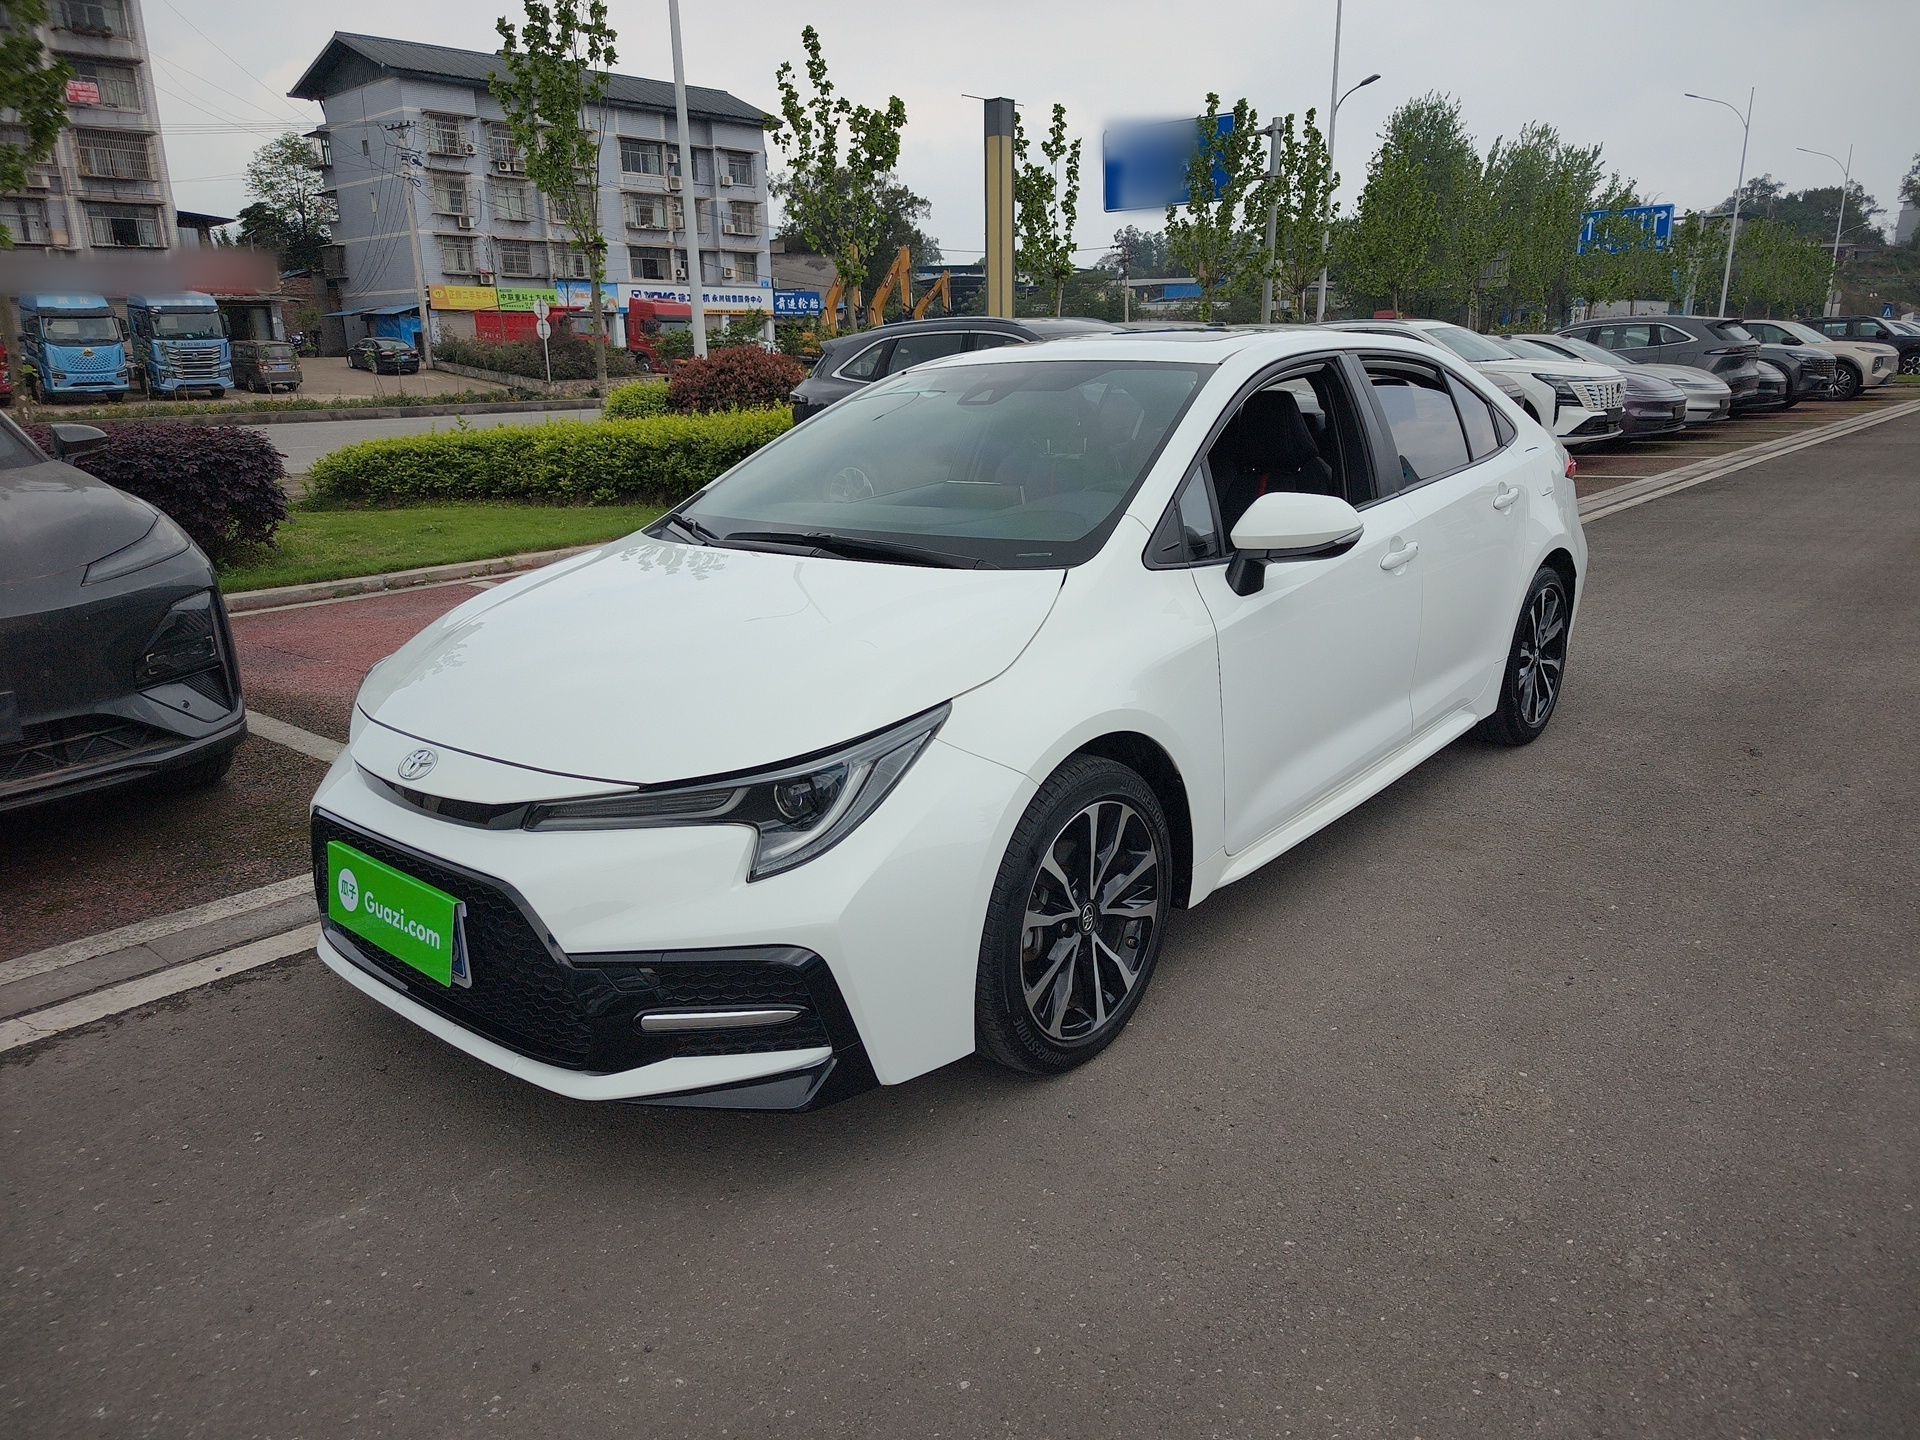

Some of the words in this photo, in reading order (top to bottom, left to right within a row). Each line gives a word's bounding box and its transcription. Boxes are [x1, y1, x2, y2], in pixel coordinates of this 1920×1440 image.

[500, 293, 556, 302] 中联重科土方机械
[776, 297, 819, 311] 前进轮胎
[340, 879, 357, 900] 瓜子
[364, 891, 441, 950] Guazi.com
